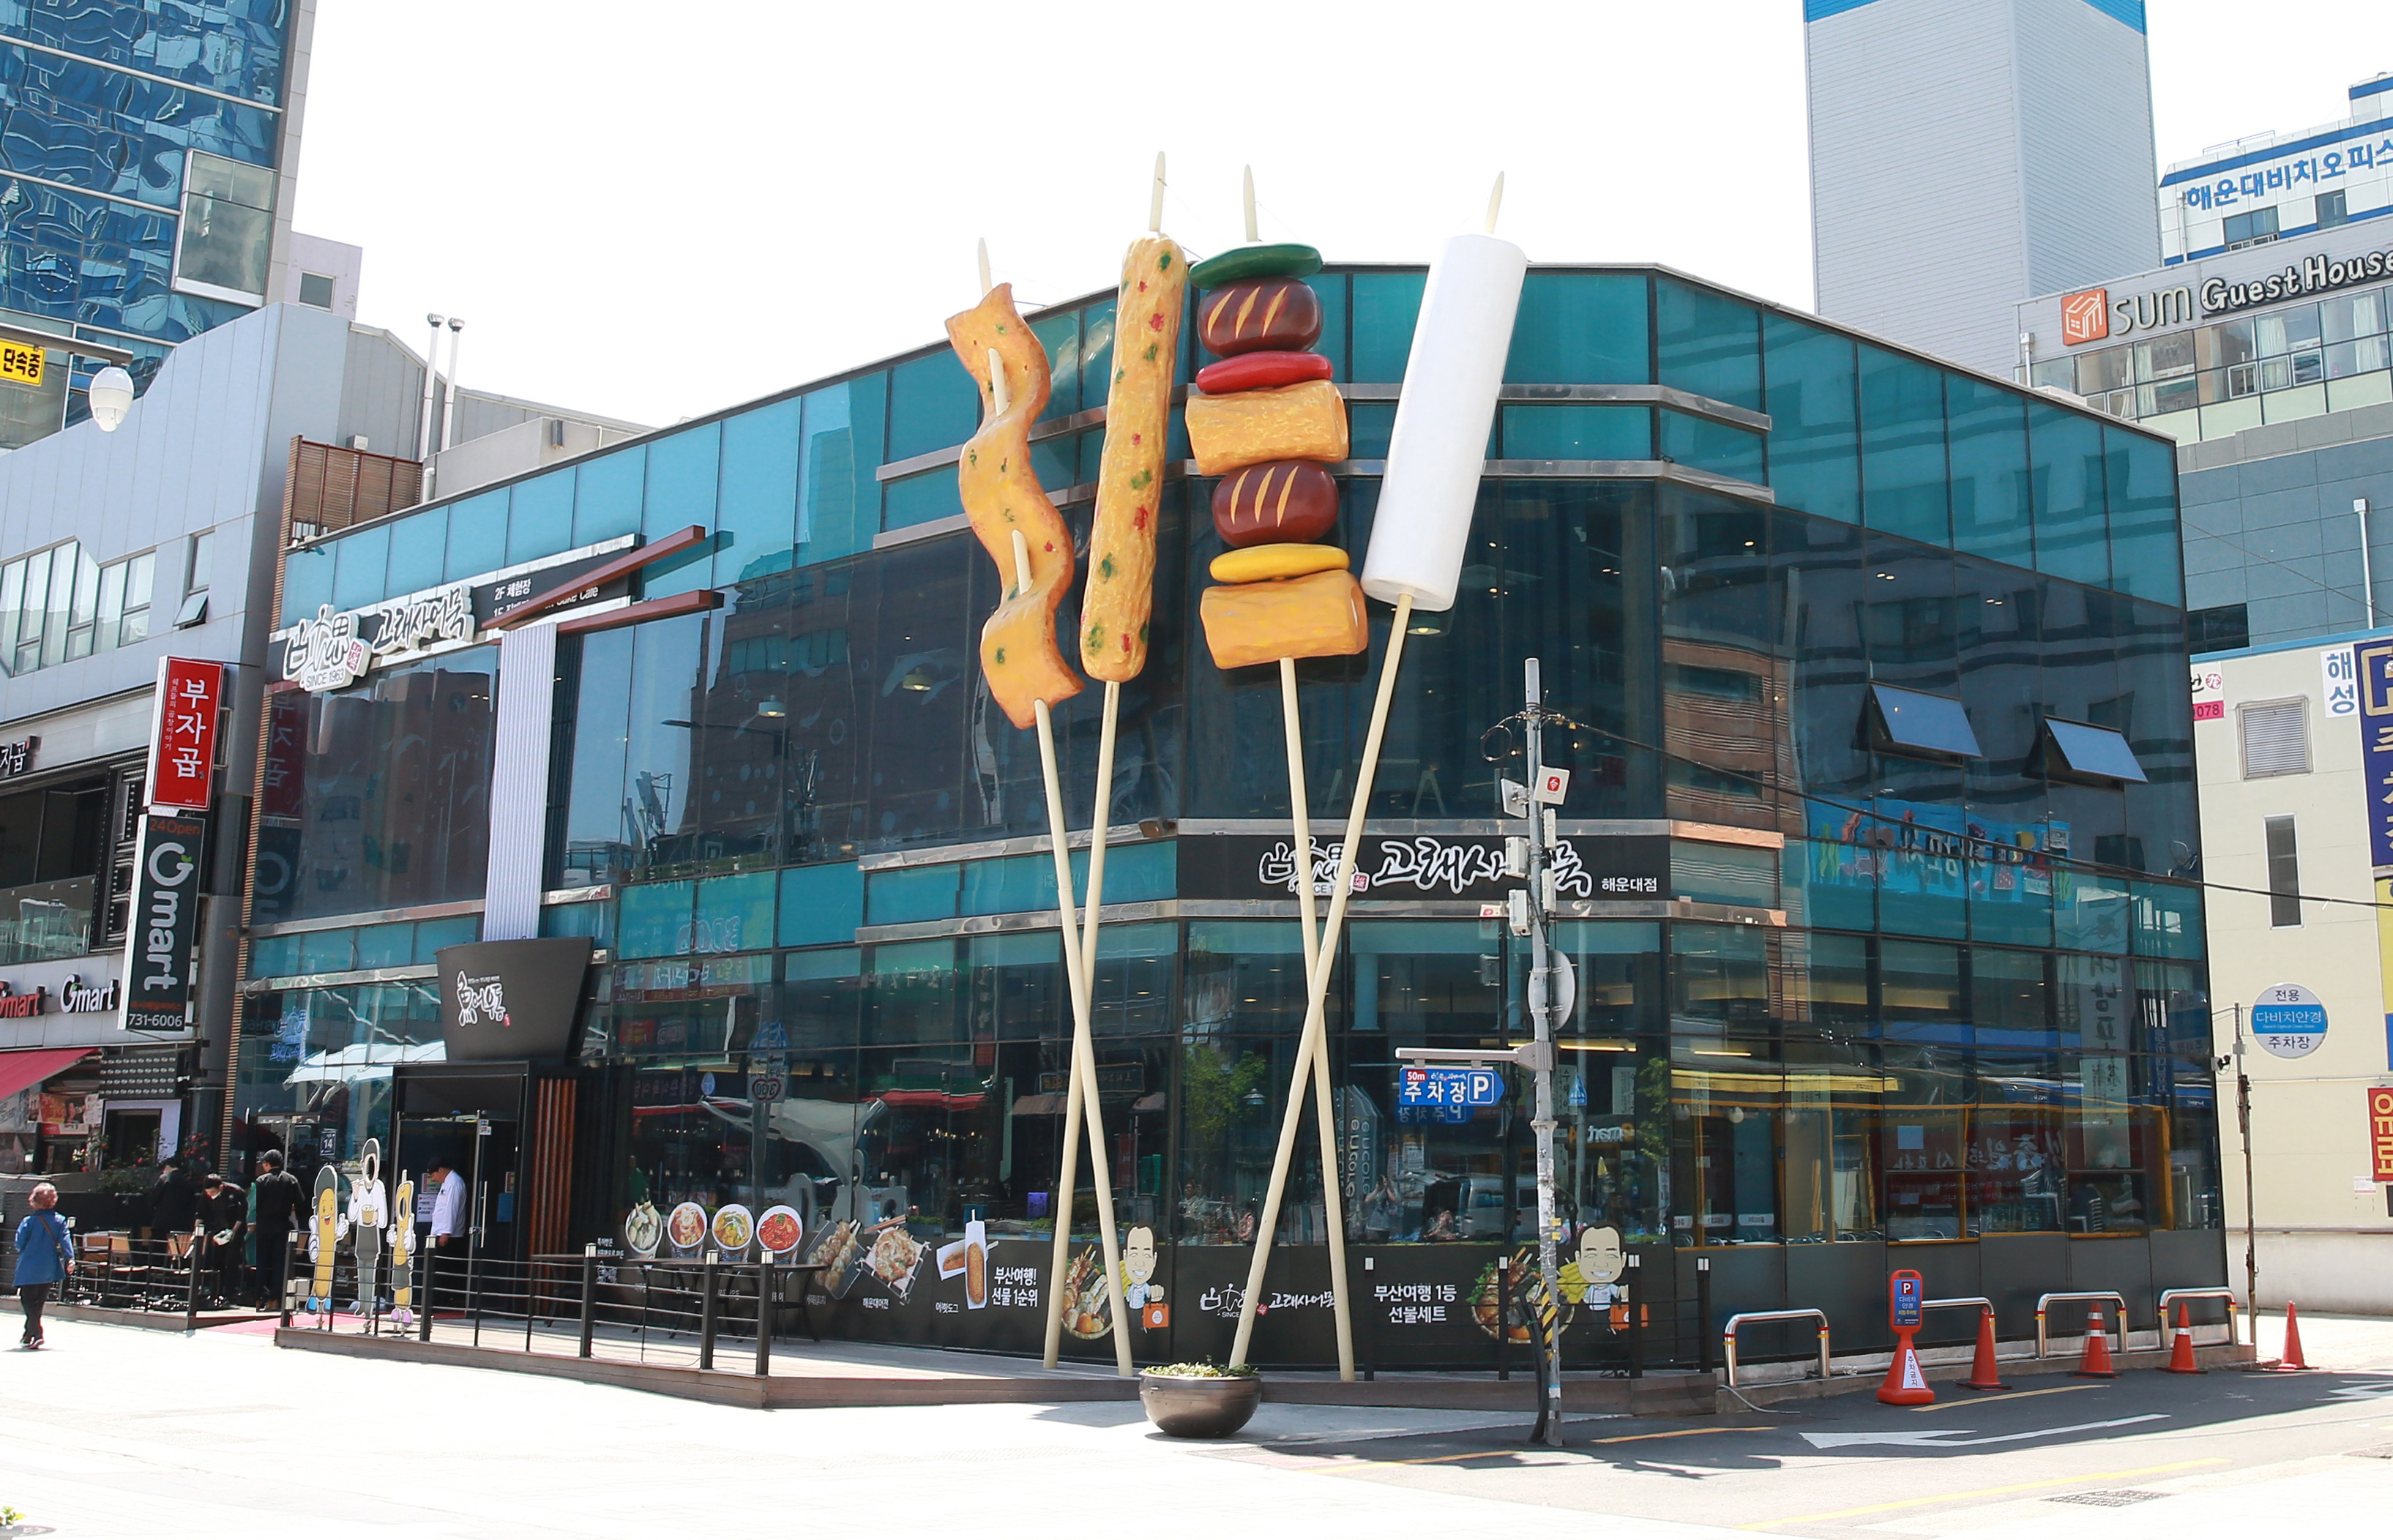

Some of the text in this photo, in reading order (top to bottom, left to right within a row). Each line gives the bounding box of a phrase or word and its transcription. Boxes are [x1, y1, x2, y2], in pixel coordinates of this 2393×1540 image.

[4, 348, 40, 378] 단속중
[495, 578, 531, 600] 2F 체험장
[305, 669, 344, 688] SINCE 1963
[2194, 703, 2220, 717] 078
[172, 679, 209, 778] 부자곱
[1373, 837, 1658, 897] 고래사묵 해운대점
[143, 842, 194, 991] Gmart
[60, 973, 115, 1014] Gmart
[2275, 989, 2300, 1002] 전용
[128, 1013, 183, 1027] 731-6006
[2255, 1010, 2321, 1023] 다비치안경
[2268, 1036, 2310, 1050] 주차장
[1407, 1072, 1426, 1081] 50m
[1405, 1081, 1467, 1104] 주차장
[1473, 1076, 1489, 1099] P
[324, 1138, 333, 1149] 14
[994, 1267, 1037, 1286] 부산여행!
[991, 1288, 1038, 1307] 선물 1순위
[1374, 1283, 1457, 1302] 부산여행 1등
[1389, 1306, 1447, 1323] 선물세트
